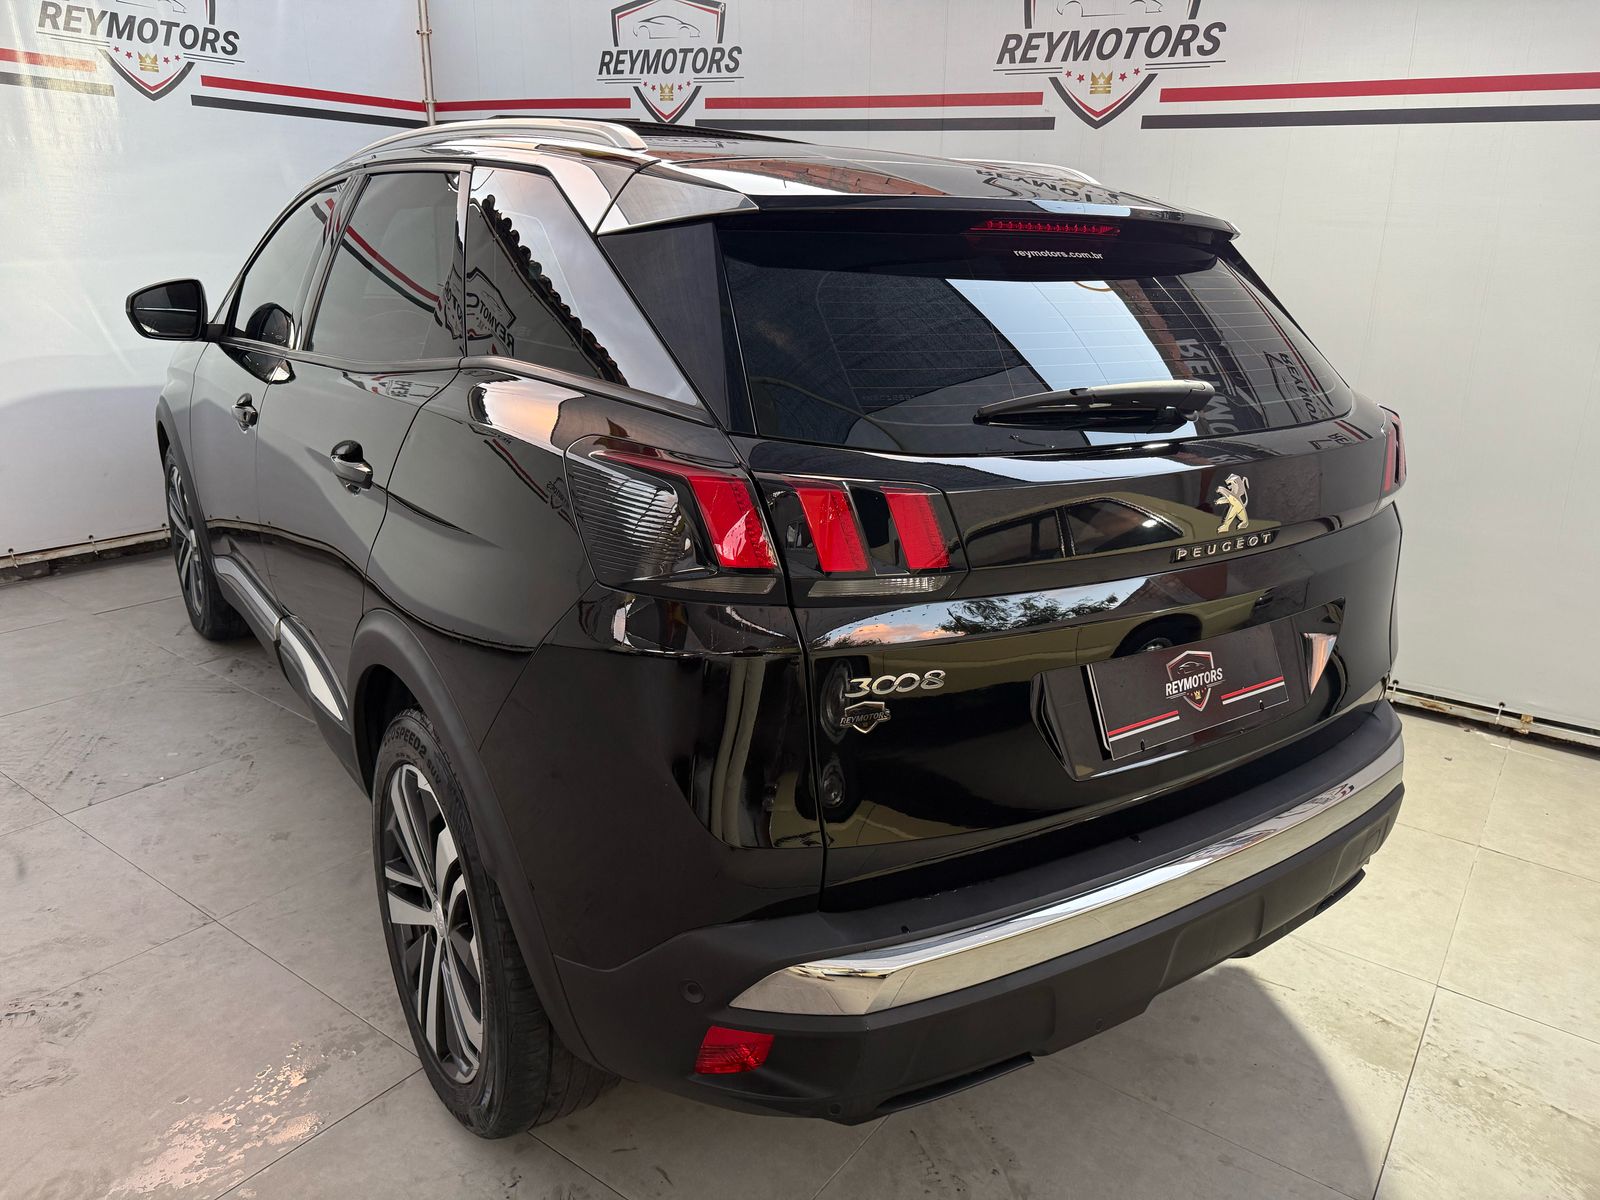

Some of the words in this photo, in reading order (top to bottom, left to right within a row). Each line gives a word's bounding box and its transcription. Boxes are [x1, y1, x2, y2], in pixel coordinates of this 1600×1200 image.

[37, 0, 240, 55] REYMOTORS
[996, 22, 1227, 64] REYMOTORS
[598, 46, 743, 75] REYMOTORS
[1013, 249, 1104, 260] reymotors.com.br
[1176, 533, 1272, 561] PEUGEOT
[845, 669, 946, 698] 3008
[1165, 667, 1223, 697] REYMOTORS
